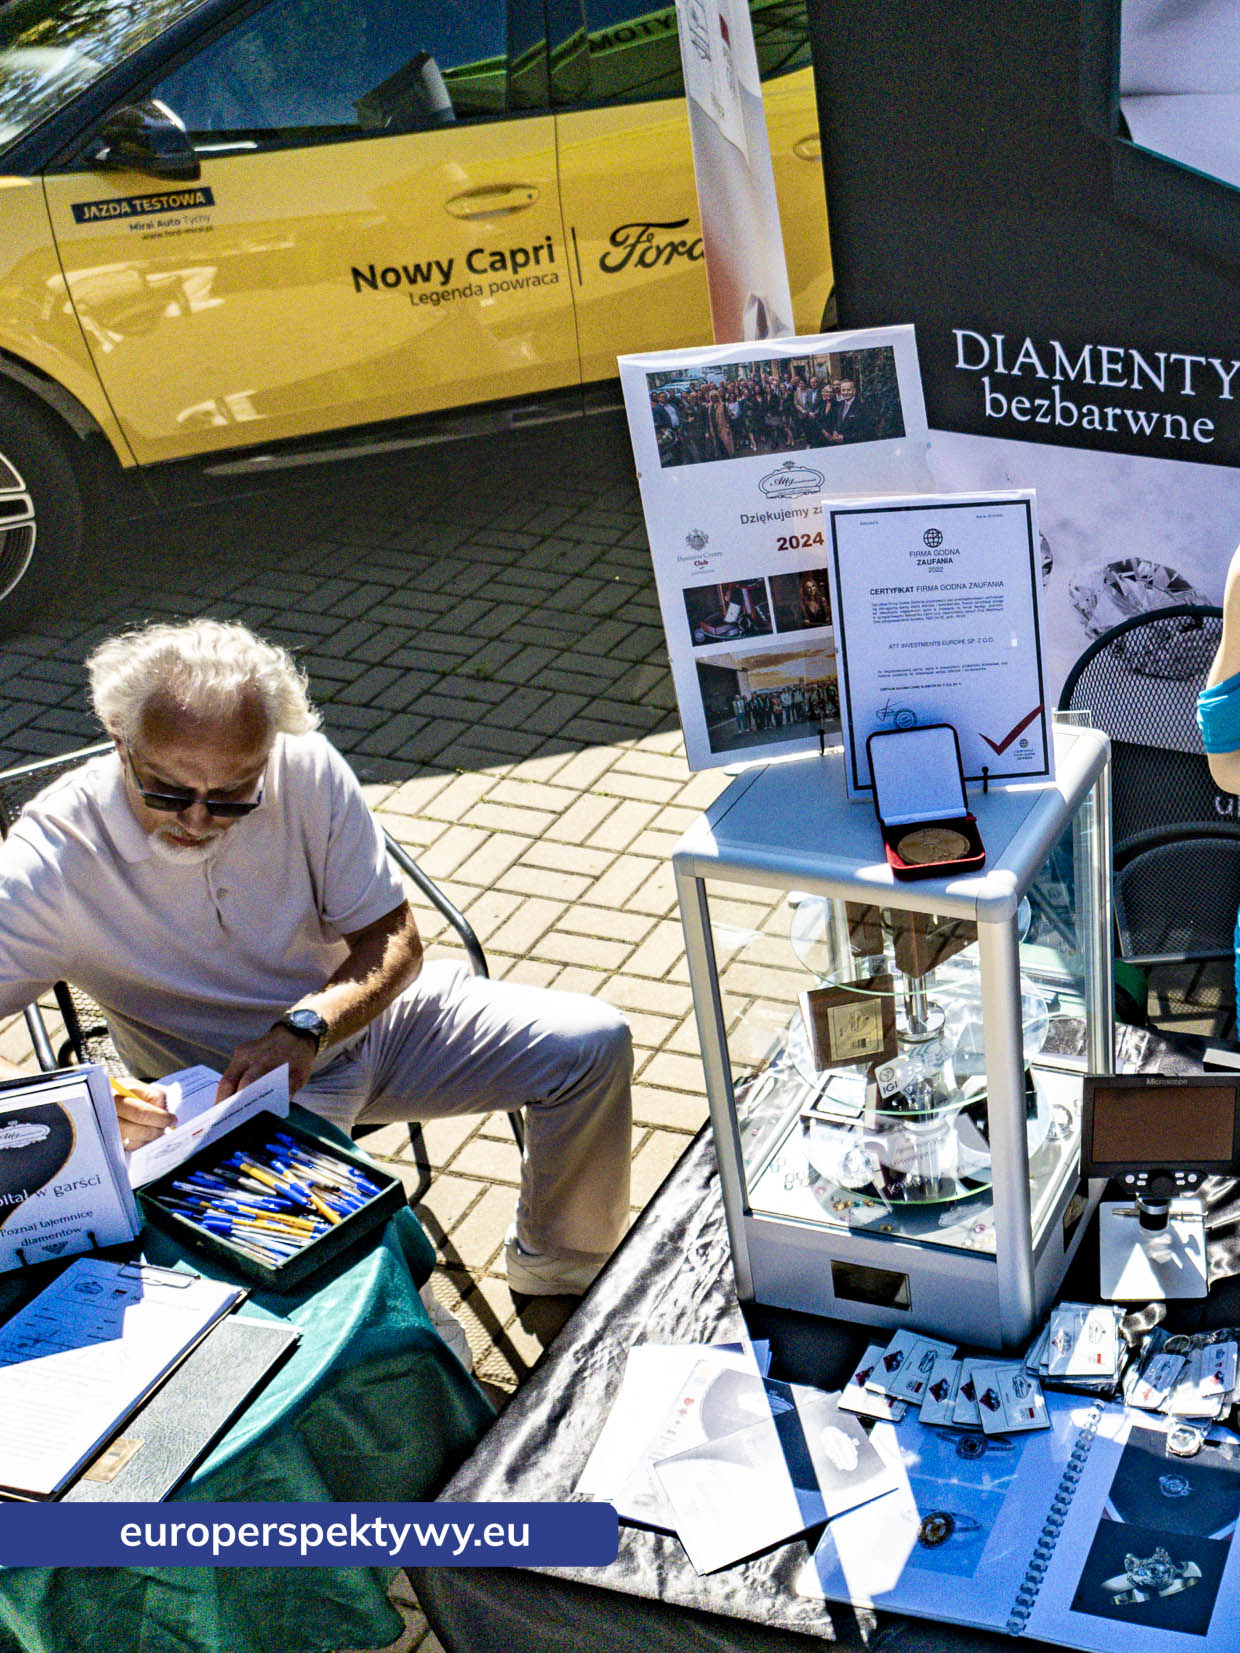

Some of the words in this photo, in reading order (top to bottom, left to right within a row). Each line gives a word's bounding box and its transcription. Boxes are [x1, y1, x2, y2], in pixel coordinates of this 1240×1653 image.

[83, 201, 131, 219] JAZDA
[132, 191, 206, 212] TESTOWA
[157, 218, 180, 228] Auto
[350, 257, 455, 293] Nowy
[465, 235, 555, 276] Capri
[408, 282, 484, 307] Legenda
[488, 270, 559, 295] powraca
[981, 376, 1215, 444] bezbarwne
[740, 507, 809, 525] Dziękujemy
[776, 532, 825, 551] 2024
[909, 550, 932, 558] FIRMA
[933, 548, 960, 557] GODNA
[694, 559, 709, 567] Club
[916, 557, 954, 566] ZAUFANIA
[870, 586, 914, 596] CERTYFIKAT
[916, 585, 939, 593] FIRMA
[940, 583, 967, 591] GODNA
[968, 580, 1004, 590] ZAUFANIA
[901, 640, 941, 649] INVESTMENTS
[942, 638, 966, 647] EUROPE
[882, 1081, 899, 1095] IGI
[36, 1188, 48, 1197] w
[40, 1210, 94, 1229] tajemnice
